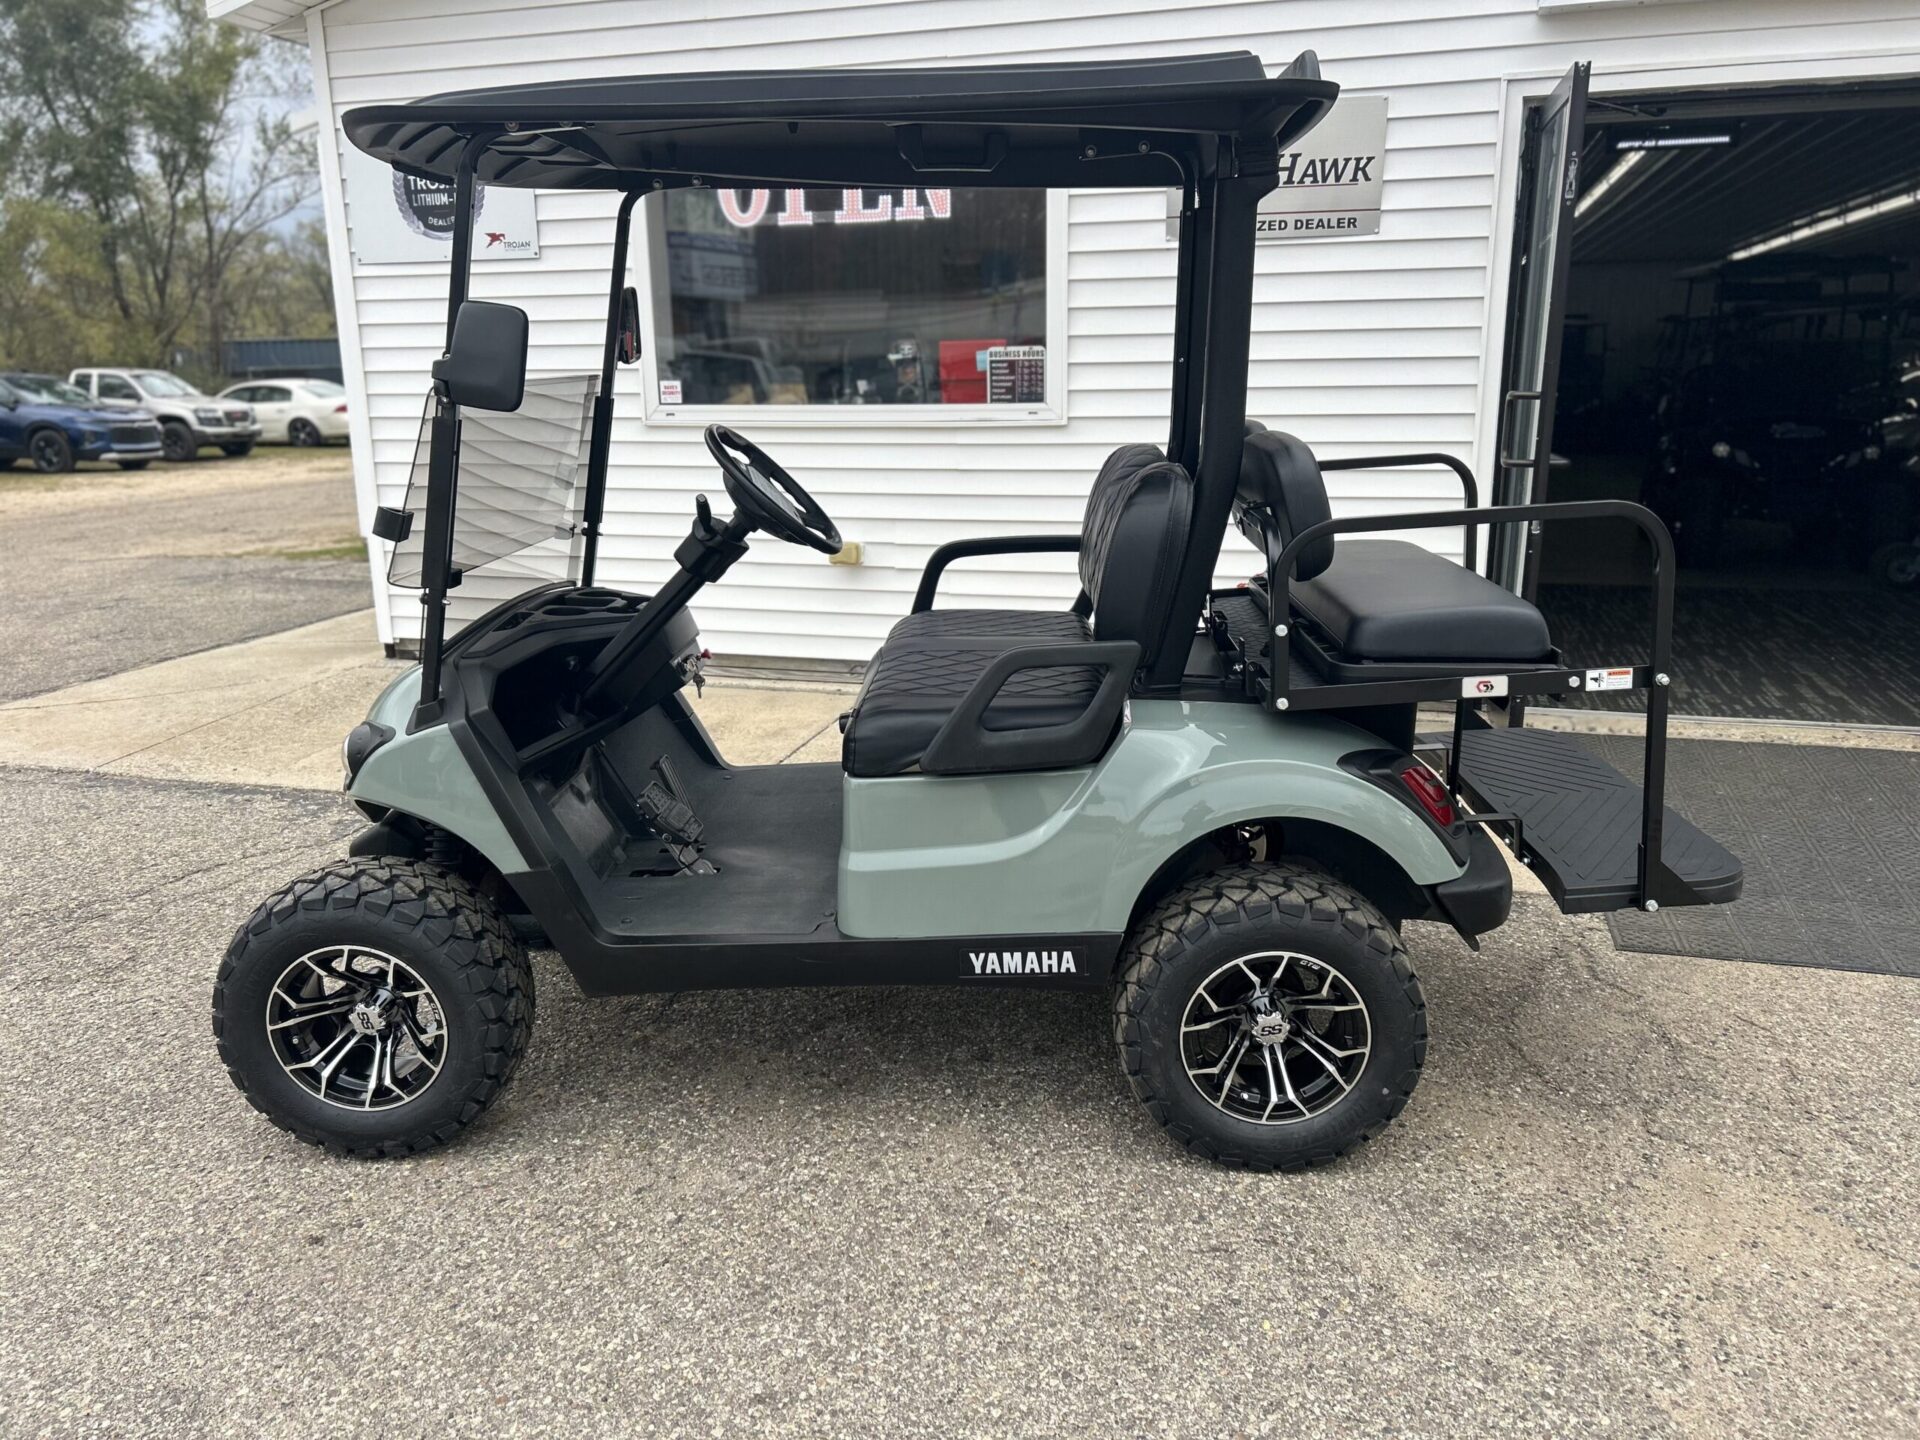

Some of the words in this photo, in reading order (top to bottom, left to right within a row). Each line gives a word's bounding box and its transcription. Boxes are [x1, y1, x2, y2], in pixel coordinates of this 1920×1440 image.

[407, 175, 457, 190] TRO
[1294, 217, 1358, 231] DEALER
[503, 240, 531, 249] TROJAN
[989, 350, 1021, 358] BUSINESS
[1022, 350, 1044, 358] HOURS
[969, 951, 1077, 974] YAMAHA
[1299, 960, 1321, 970] GTW
[1260, 1024, 1283, 1036] SS
